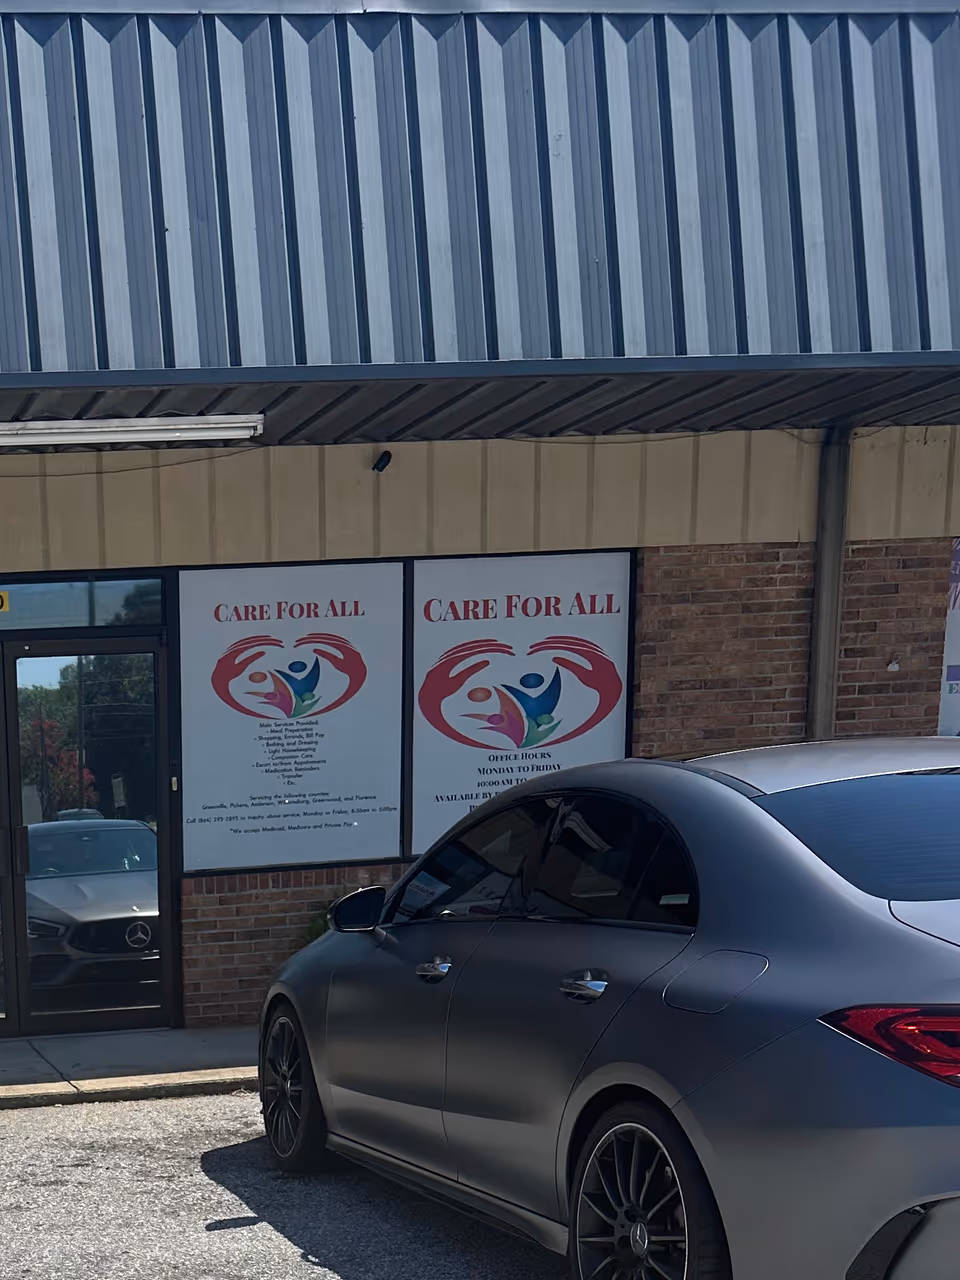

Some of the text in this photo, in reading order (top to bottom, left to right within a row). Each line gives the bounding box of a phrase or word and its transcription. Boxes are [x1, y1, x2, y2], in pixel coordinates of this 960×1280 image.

[213, 597, 365, 623] CARE FOR ALL
[424, 592, 621, 622] CARE FOR ALL
[488, 752, 552, 762] OFFICE HOURS
[477, 766, 516, 776] MONDAY
[531, 763, 562, 772] FRIDAY
